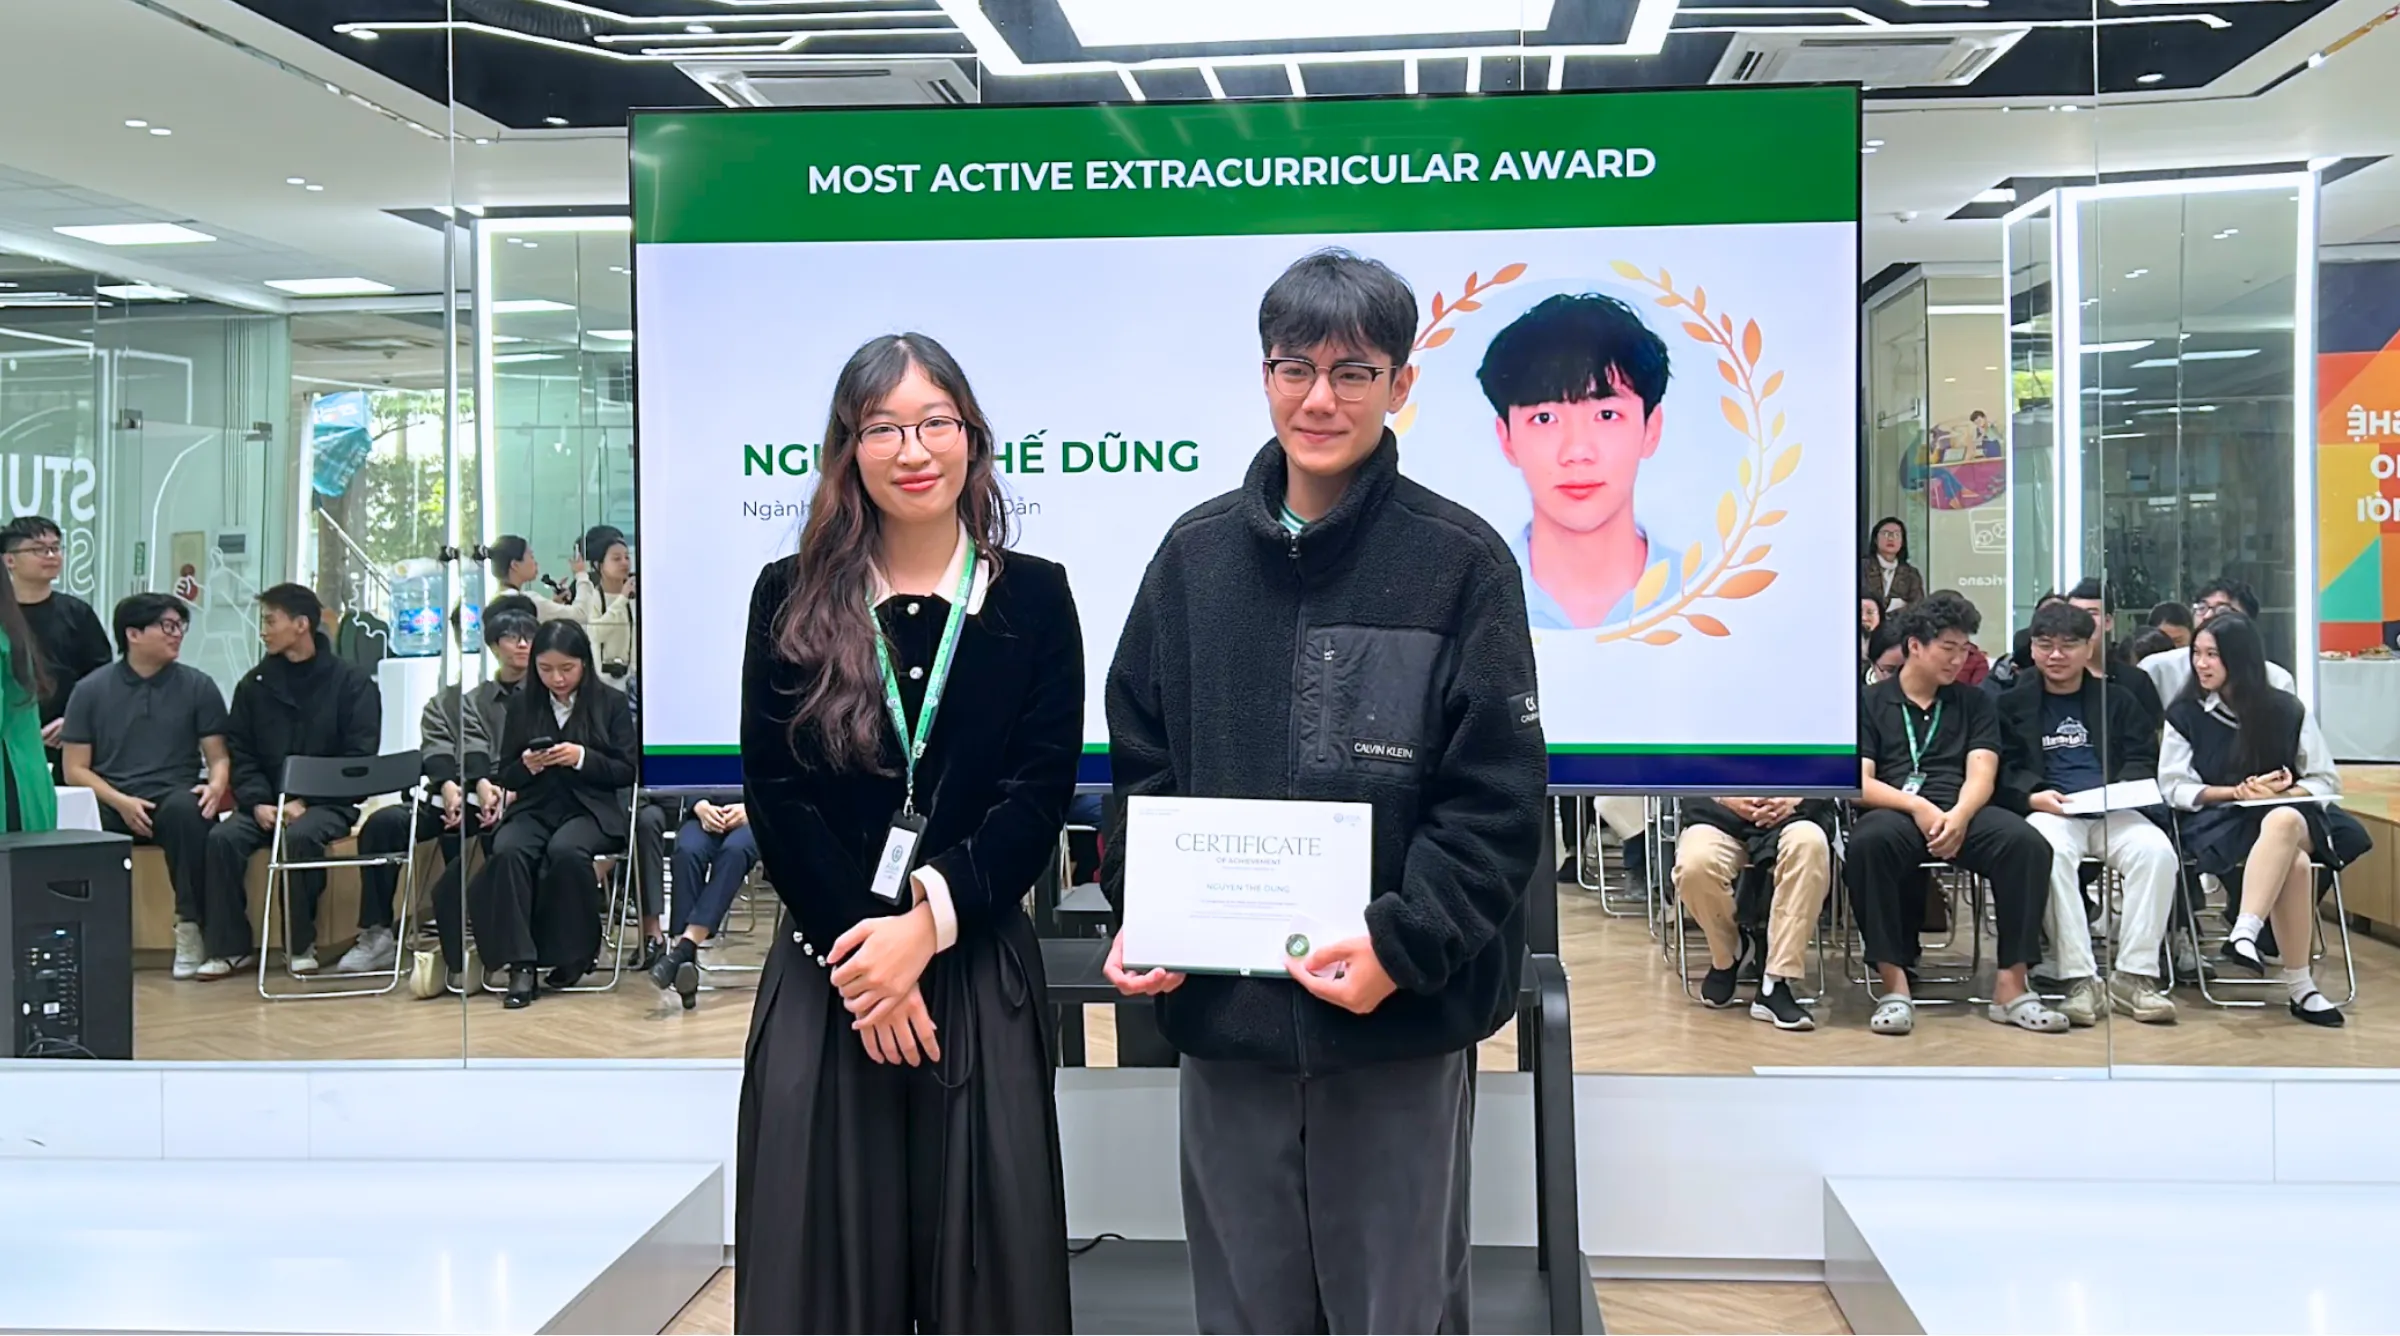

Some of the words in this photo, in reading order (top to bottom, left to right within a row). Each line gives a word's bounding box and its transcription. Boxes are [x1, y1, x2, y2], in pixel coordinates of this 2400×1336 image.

[808, 163, 921, 195] MOST
[930, 161, 1074, 193] ACTIVE
[1086, 153, 1480, 190] EXTRACURRICULAR
[1489, 147, 1657, 182] AWARD
[1062, 431, 1199, 474] DŨNG
[1354, 742, 1385, 756] CALVIN
[1386, 746, 1413, 759] KLEIN
[1175, 832, 1322, 857] CERTIFICATE
[1228, 857, 1281, 867] ACHIEVEMENT
